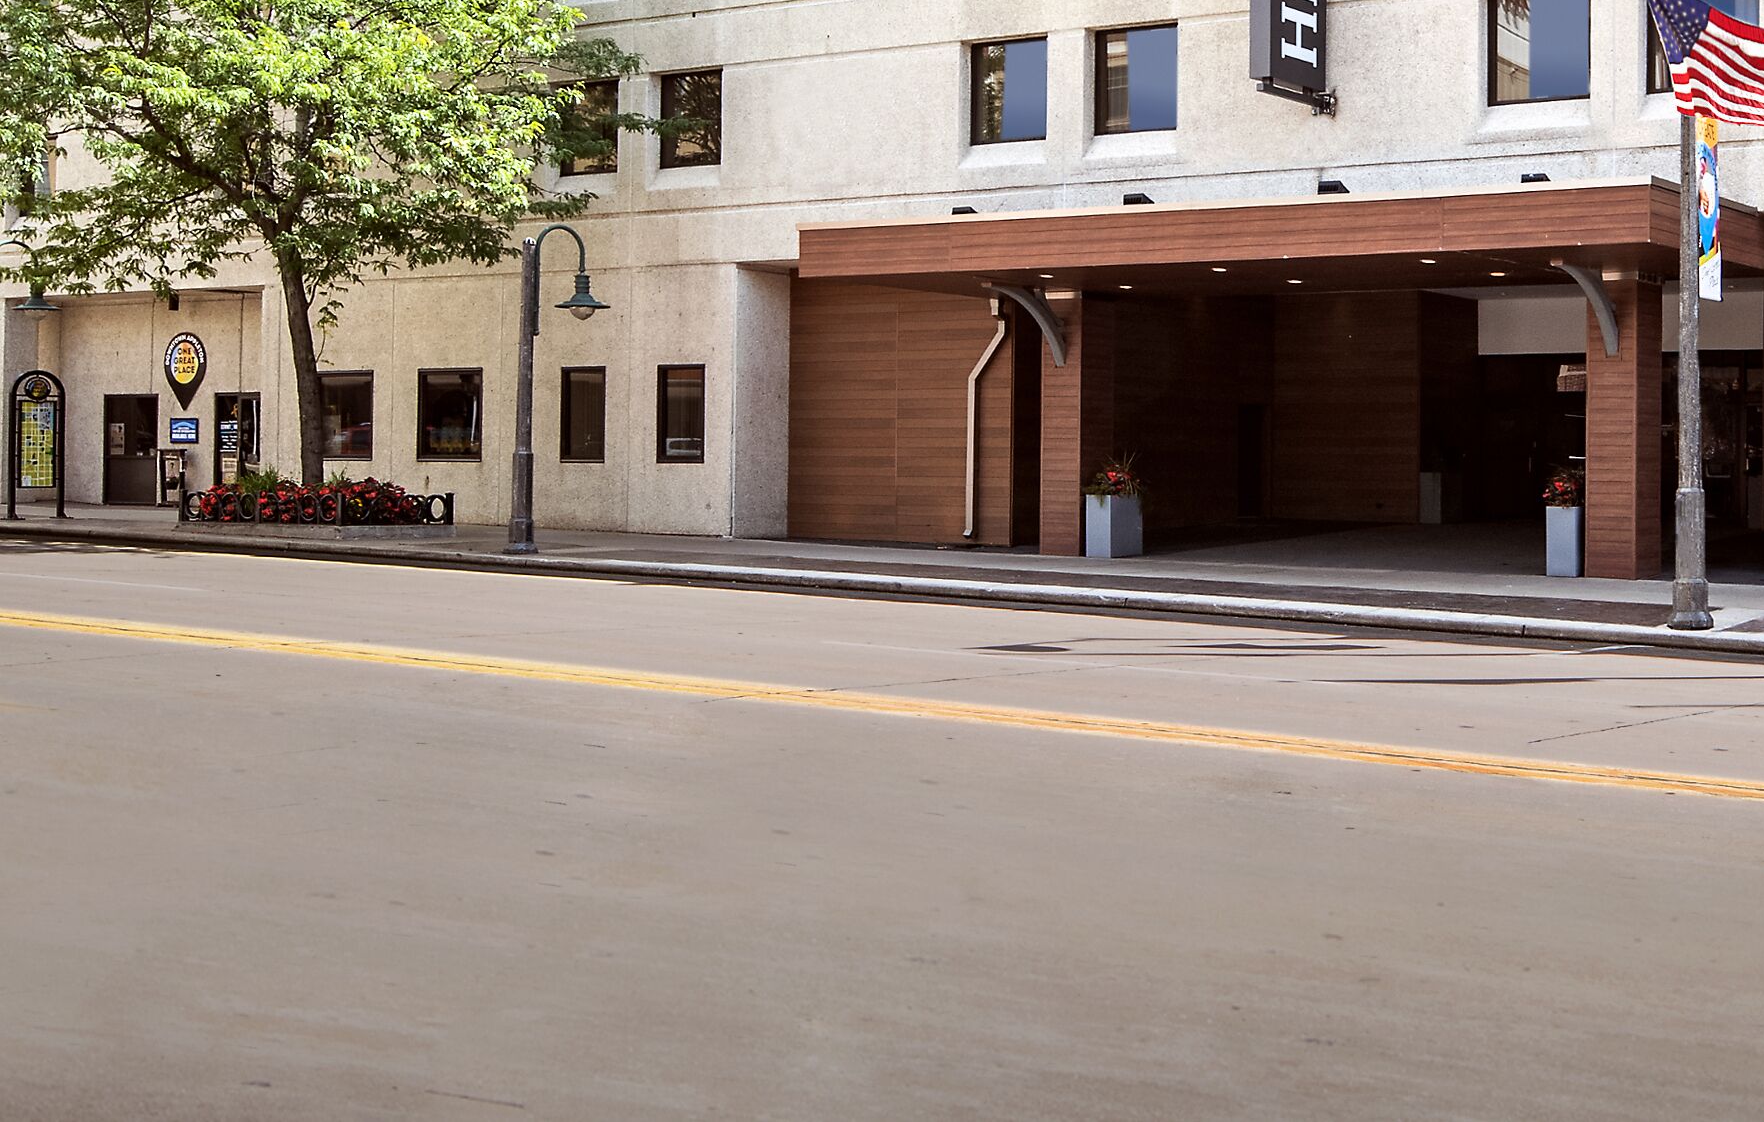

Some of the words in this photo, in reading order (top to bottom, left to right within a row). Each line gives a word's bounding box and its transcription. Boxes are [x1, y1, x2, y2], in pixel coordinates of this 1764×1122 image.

[165, 334, 187, 366] DOWNTOWN
[187, 334, 205, 364] APPLETON
[177, 347, 191, 355] ONE
[174, 356, 195, 365] GREAT
[174, 366, 195, 374] PLACE
